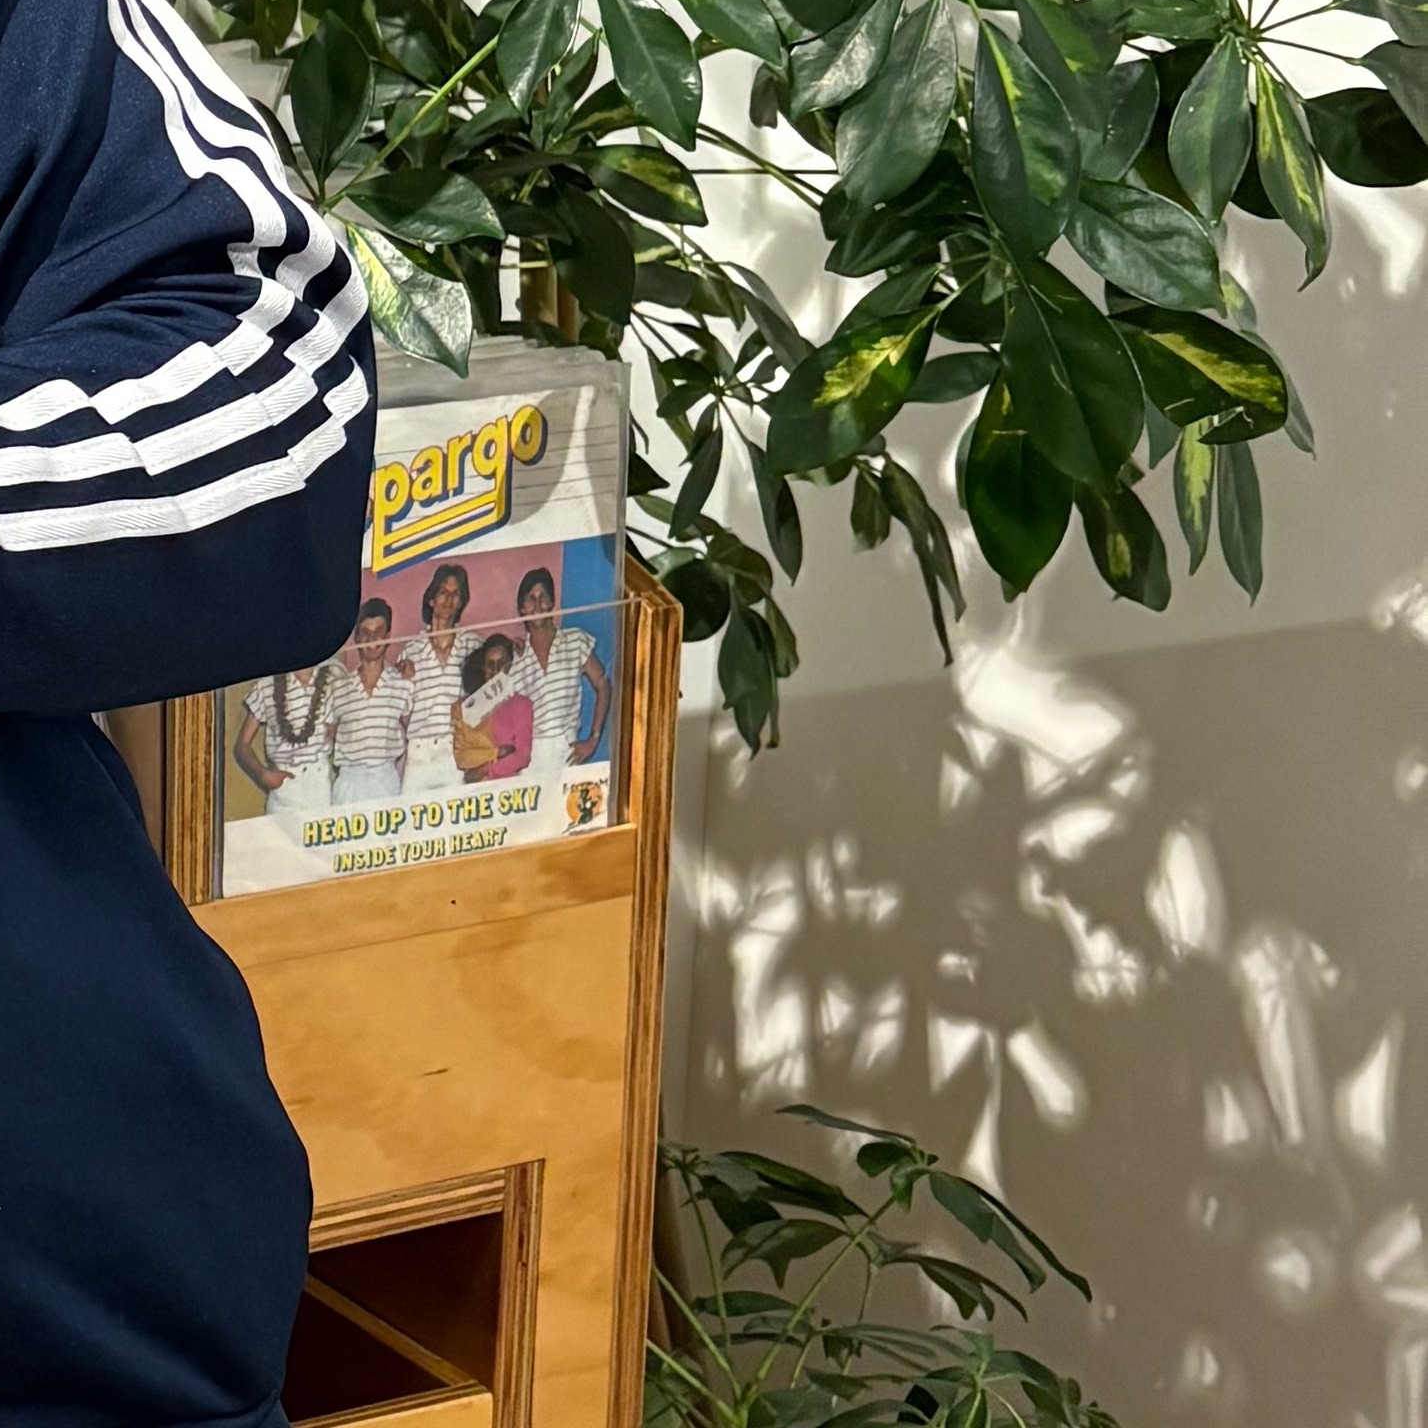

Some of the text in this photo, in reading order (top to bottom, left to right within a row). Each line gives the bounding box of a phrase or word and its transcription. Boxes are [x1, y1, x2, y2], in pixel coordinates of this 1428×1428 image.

[366, 404, 548, 578] pargo
[304, 813, 368, 847] HEAD
[373, 808, 406, 836] UP
[411, 802, 444, 830] TO
[448, 794, 495, 822] THE
[498, 785, 541, 814] SKY
[334, 827, 508, 873] INSIDE YOUR HEART
